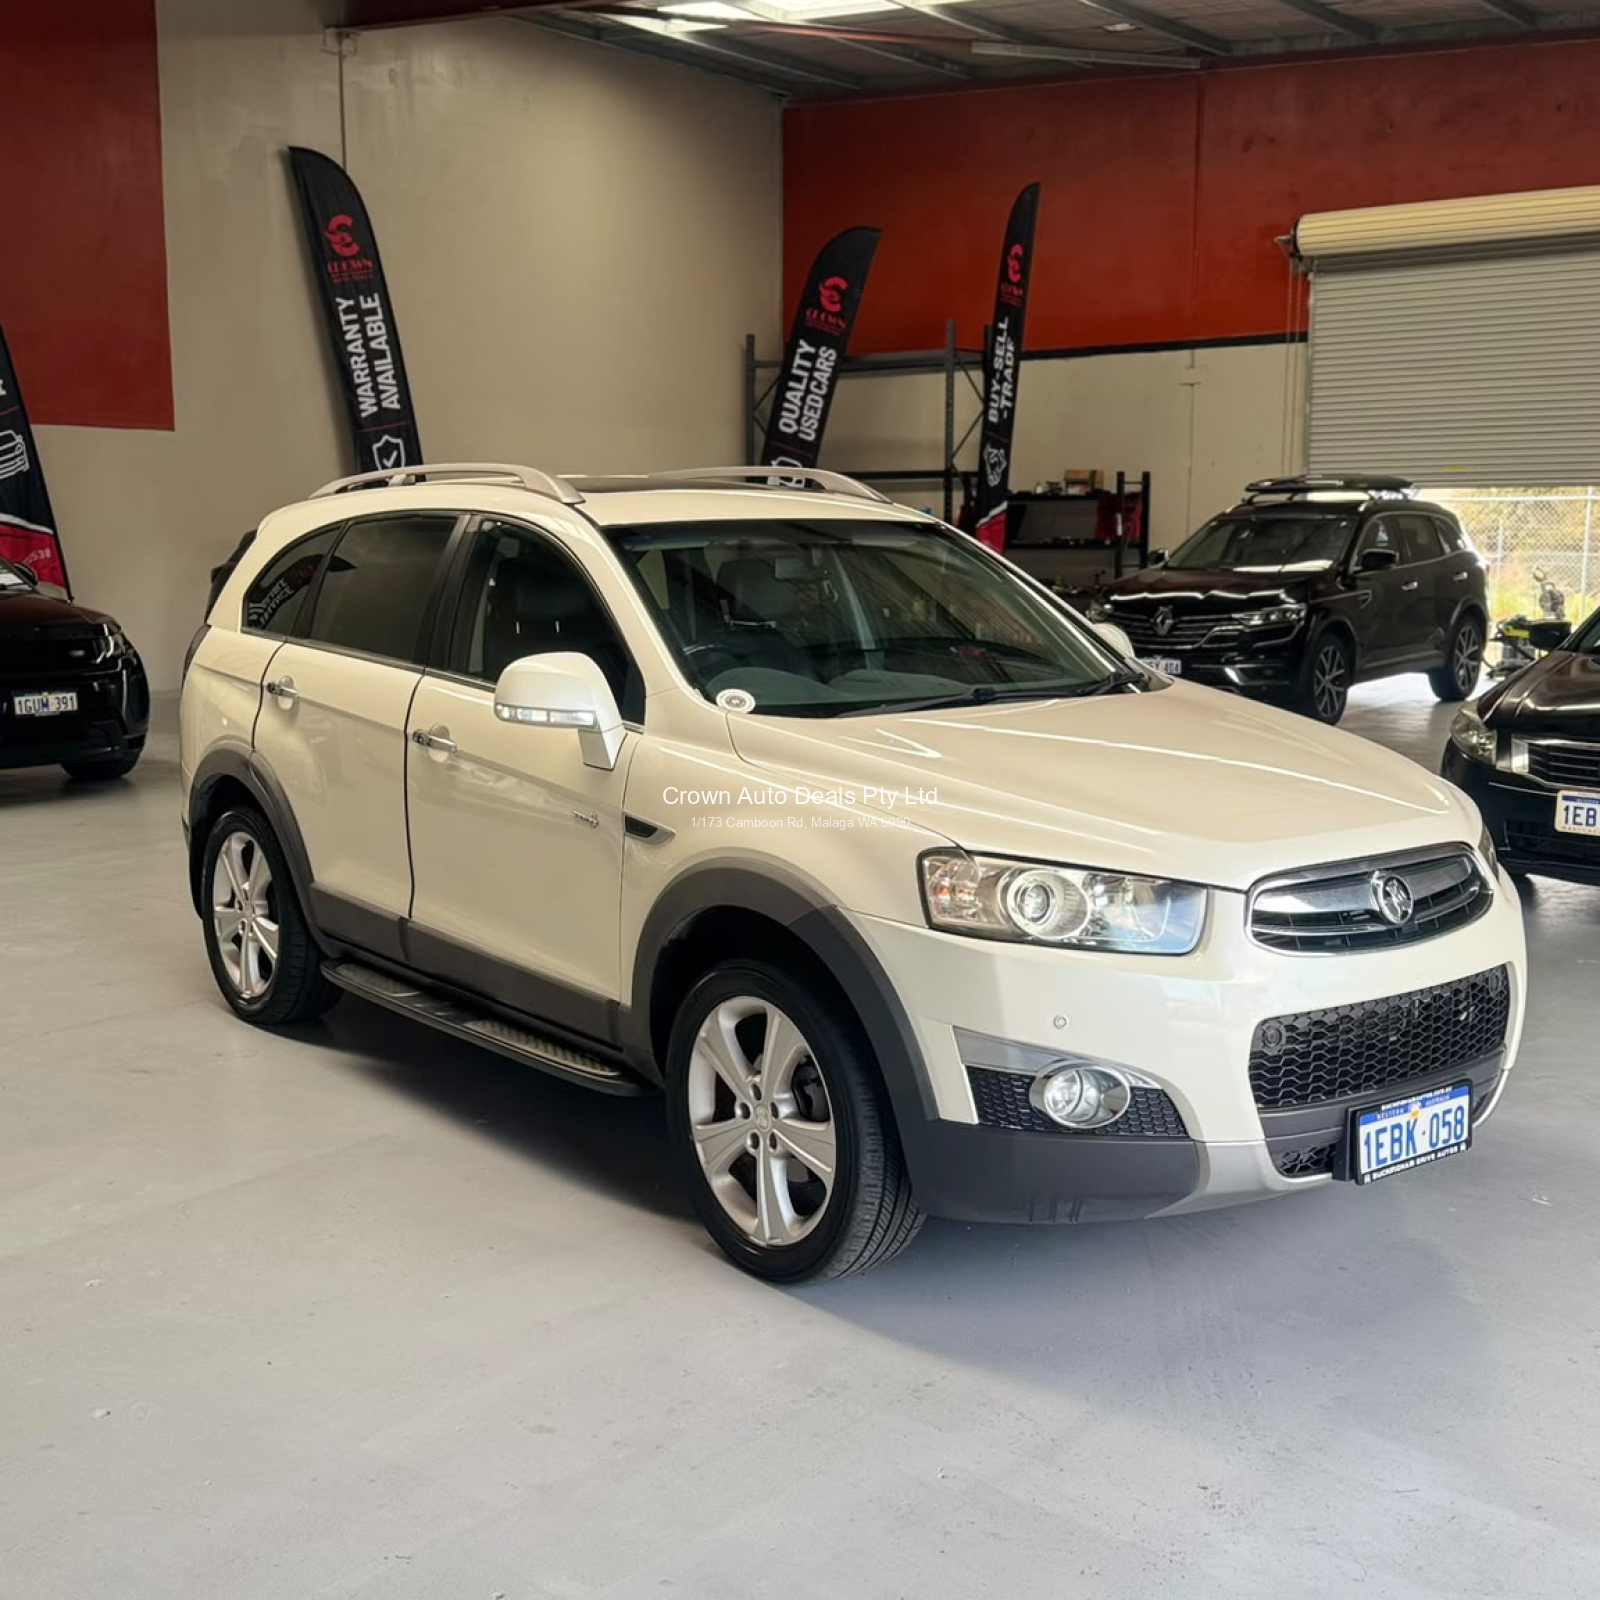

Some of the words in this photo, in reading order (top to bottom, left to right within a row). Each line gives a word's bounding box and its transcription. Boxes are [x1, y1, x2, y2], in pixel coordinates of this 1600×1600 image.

[335, 296, 378, 418] WARRANTY
[359, 292, 401, 410] AVAILABLE
[778, 339, 816, 434] QUALITY
[809, 346, 837, 396] CARS
[988, 316, 1009, 422] BUY-SELL
[798, 394, 824, 441] USED
[54, 694, 75, 712] 391
[1363, 1117, 1418, 1170] 1EBK
[1428, 1105, 1465, 1149] 058
